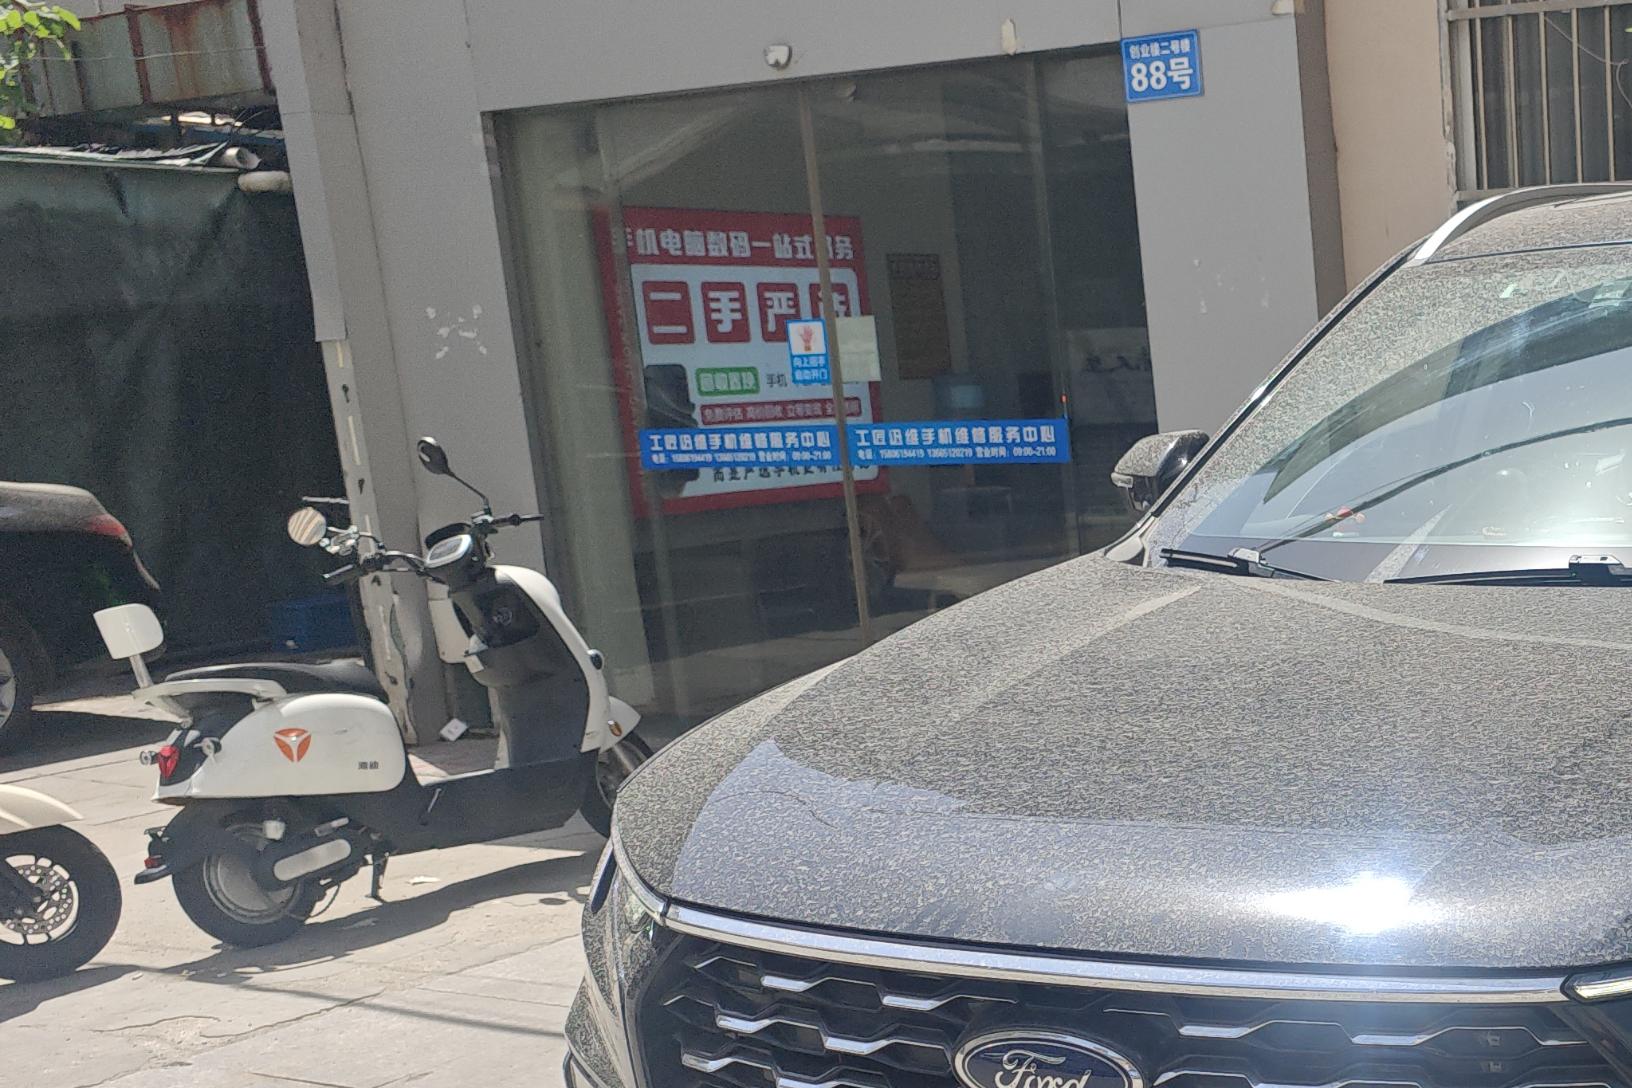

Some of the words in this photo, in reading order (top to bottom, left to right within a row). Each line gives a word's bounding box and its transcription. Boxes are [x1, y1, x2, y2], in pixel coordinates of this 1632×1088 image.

[1131, 57, 1194, 92] 88号
[624, 228, 854, 260] 机电脑数码一站式务
